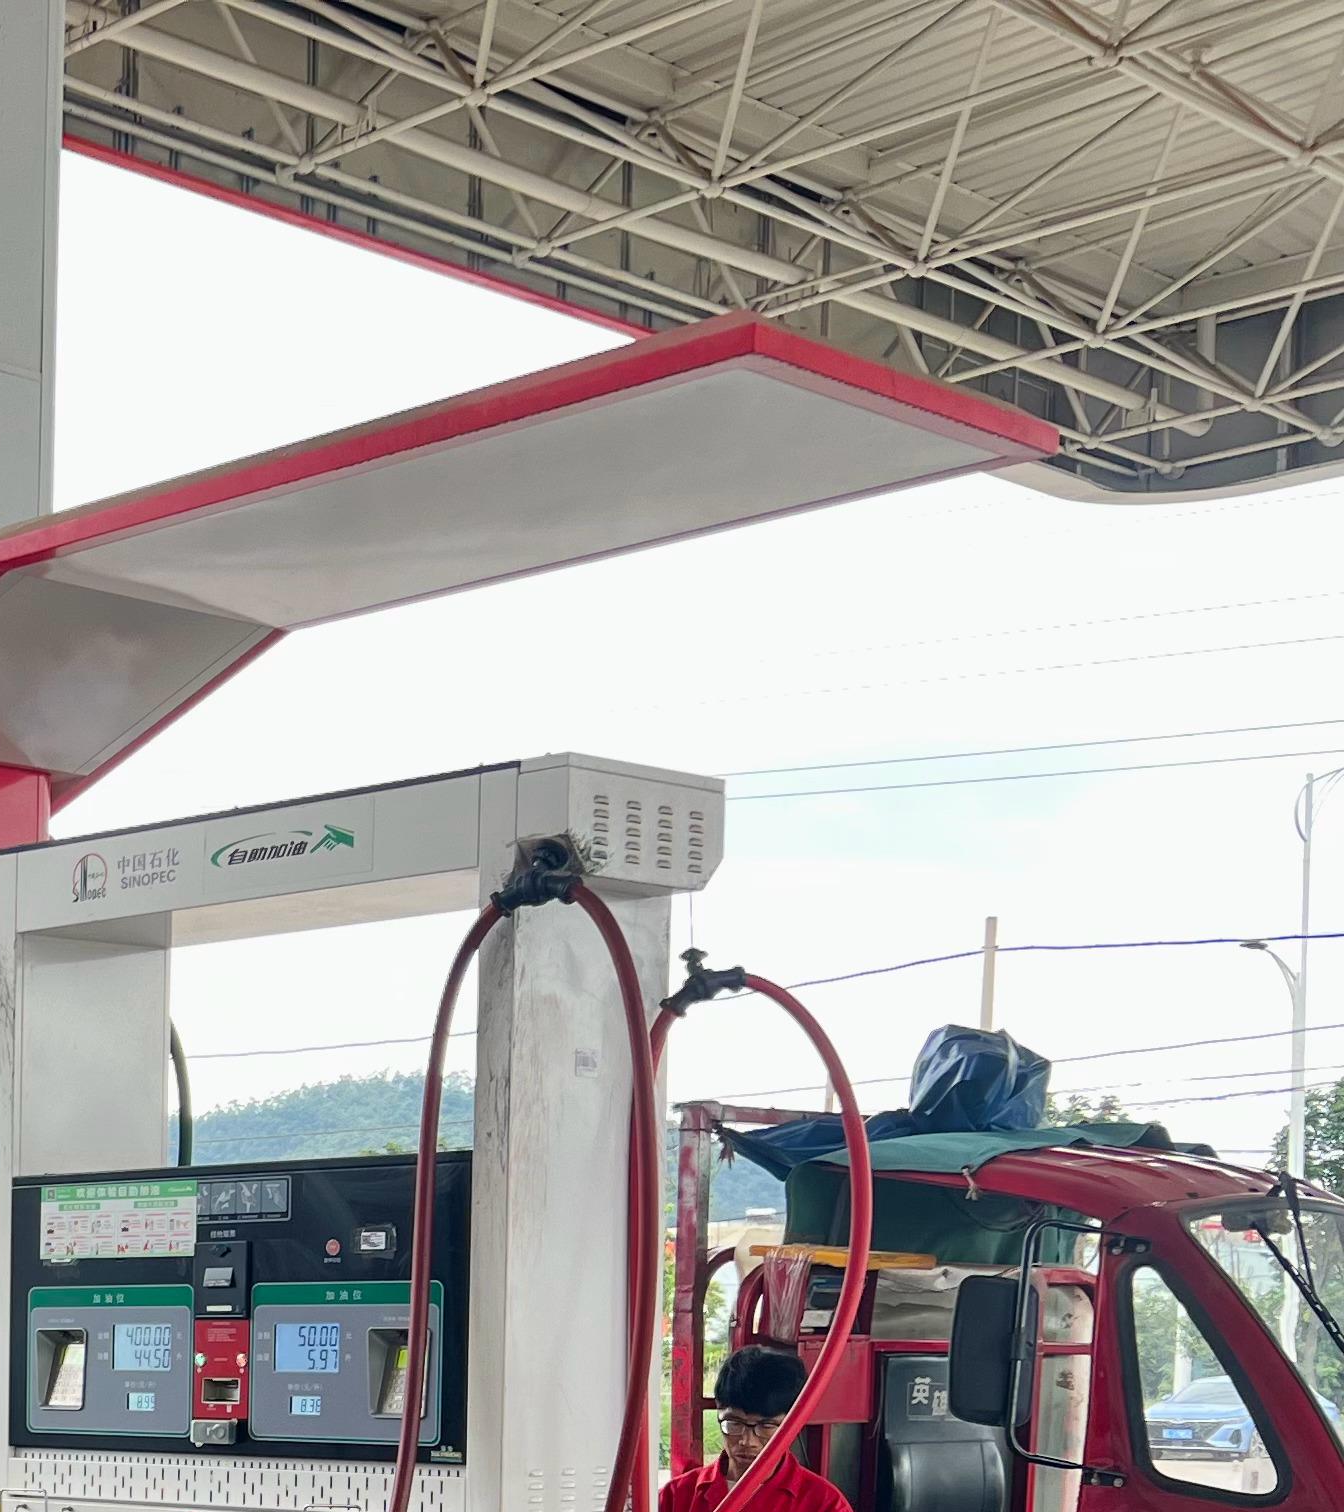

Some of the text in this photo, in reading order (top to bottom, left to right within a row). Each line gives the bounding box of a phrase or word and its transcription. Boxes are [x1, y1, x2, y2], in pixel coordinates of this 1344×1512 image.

[116, 847, 181, 875] 中国石化
[227, 840, 309, 866] 自助加油
[120, 869, 177, 890] SINOPEC
[126, 1326, 171, 1347] 400.00
[298, 1325, 339, 1347] 50.00
[308, 1349, 338, 1370] 5.97
